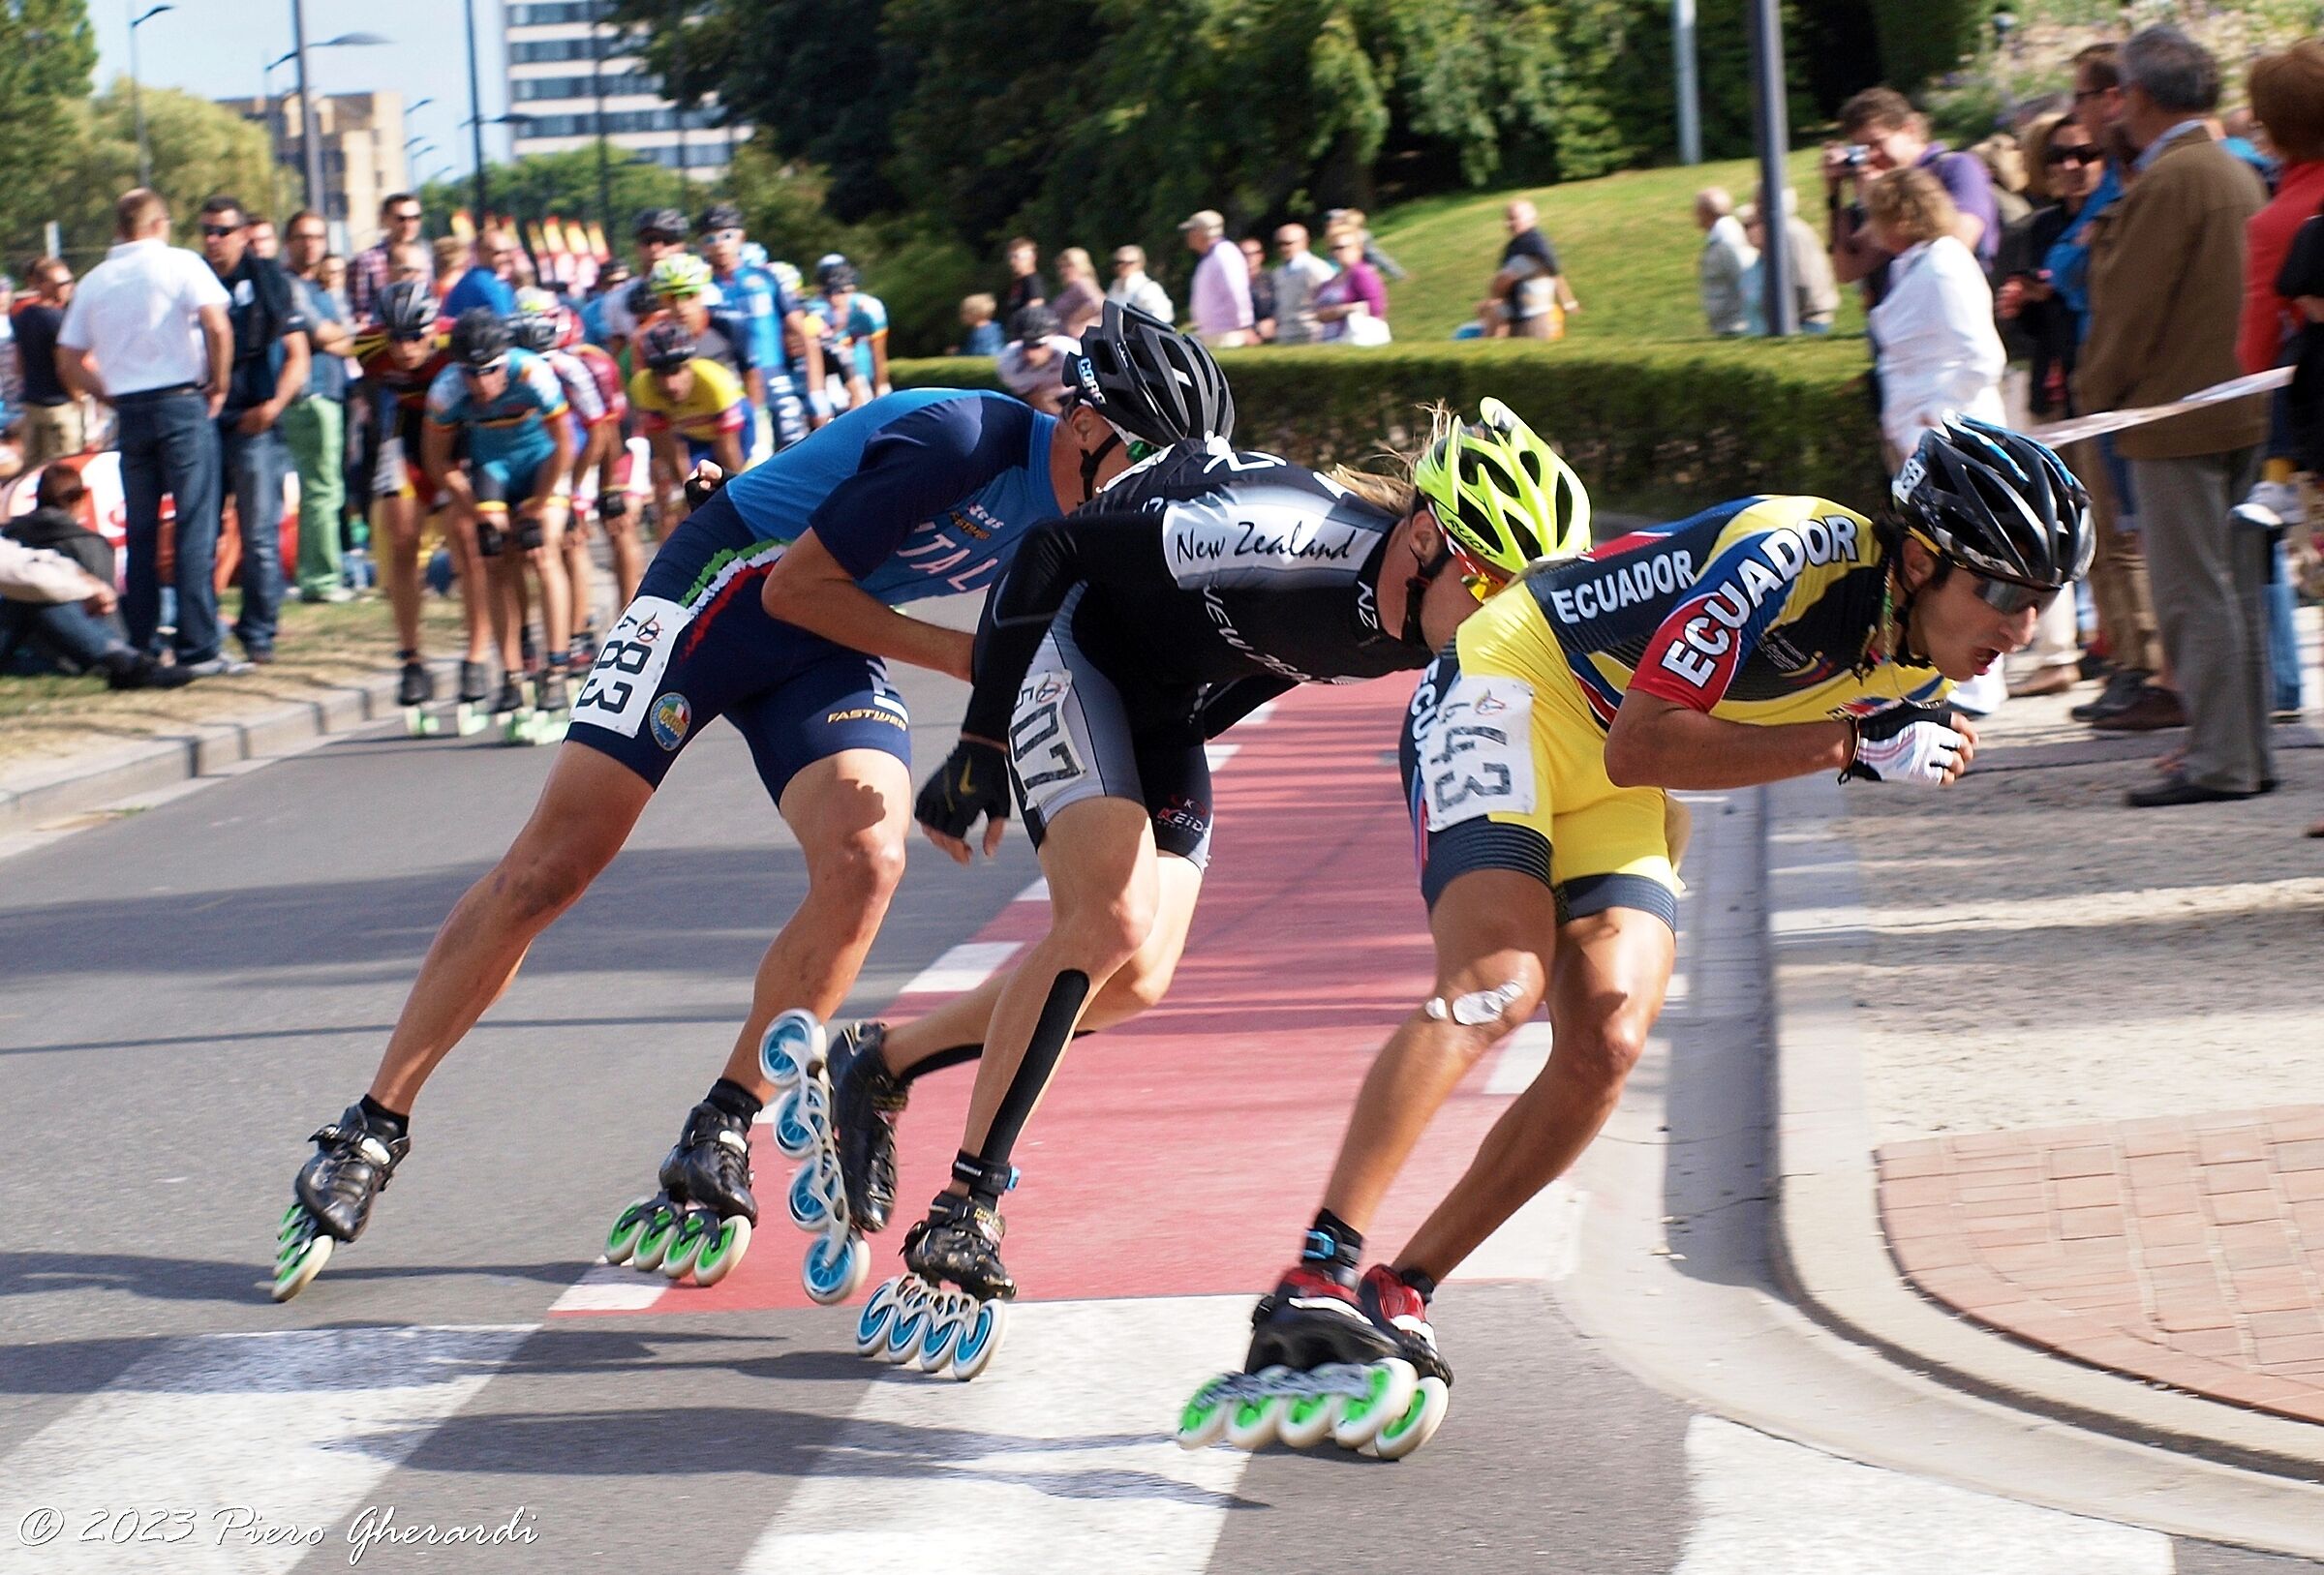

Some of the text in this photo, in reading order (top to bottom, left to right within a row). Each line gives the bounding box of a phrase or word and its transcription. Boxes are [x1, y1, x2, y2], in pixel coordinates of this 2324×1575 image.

[1176, 520, 1357, 564] New Zealand
[1550, 549, 1697, 625] ECUADOR
[1662, 515, 1860, 688] ECUADOR
